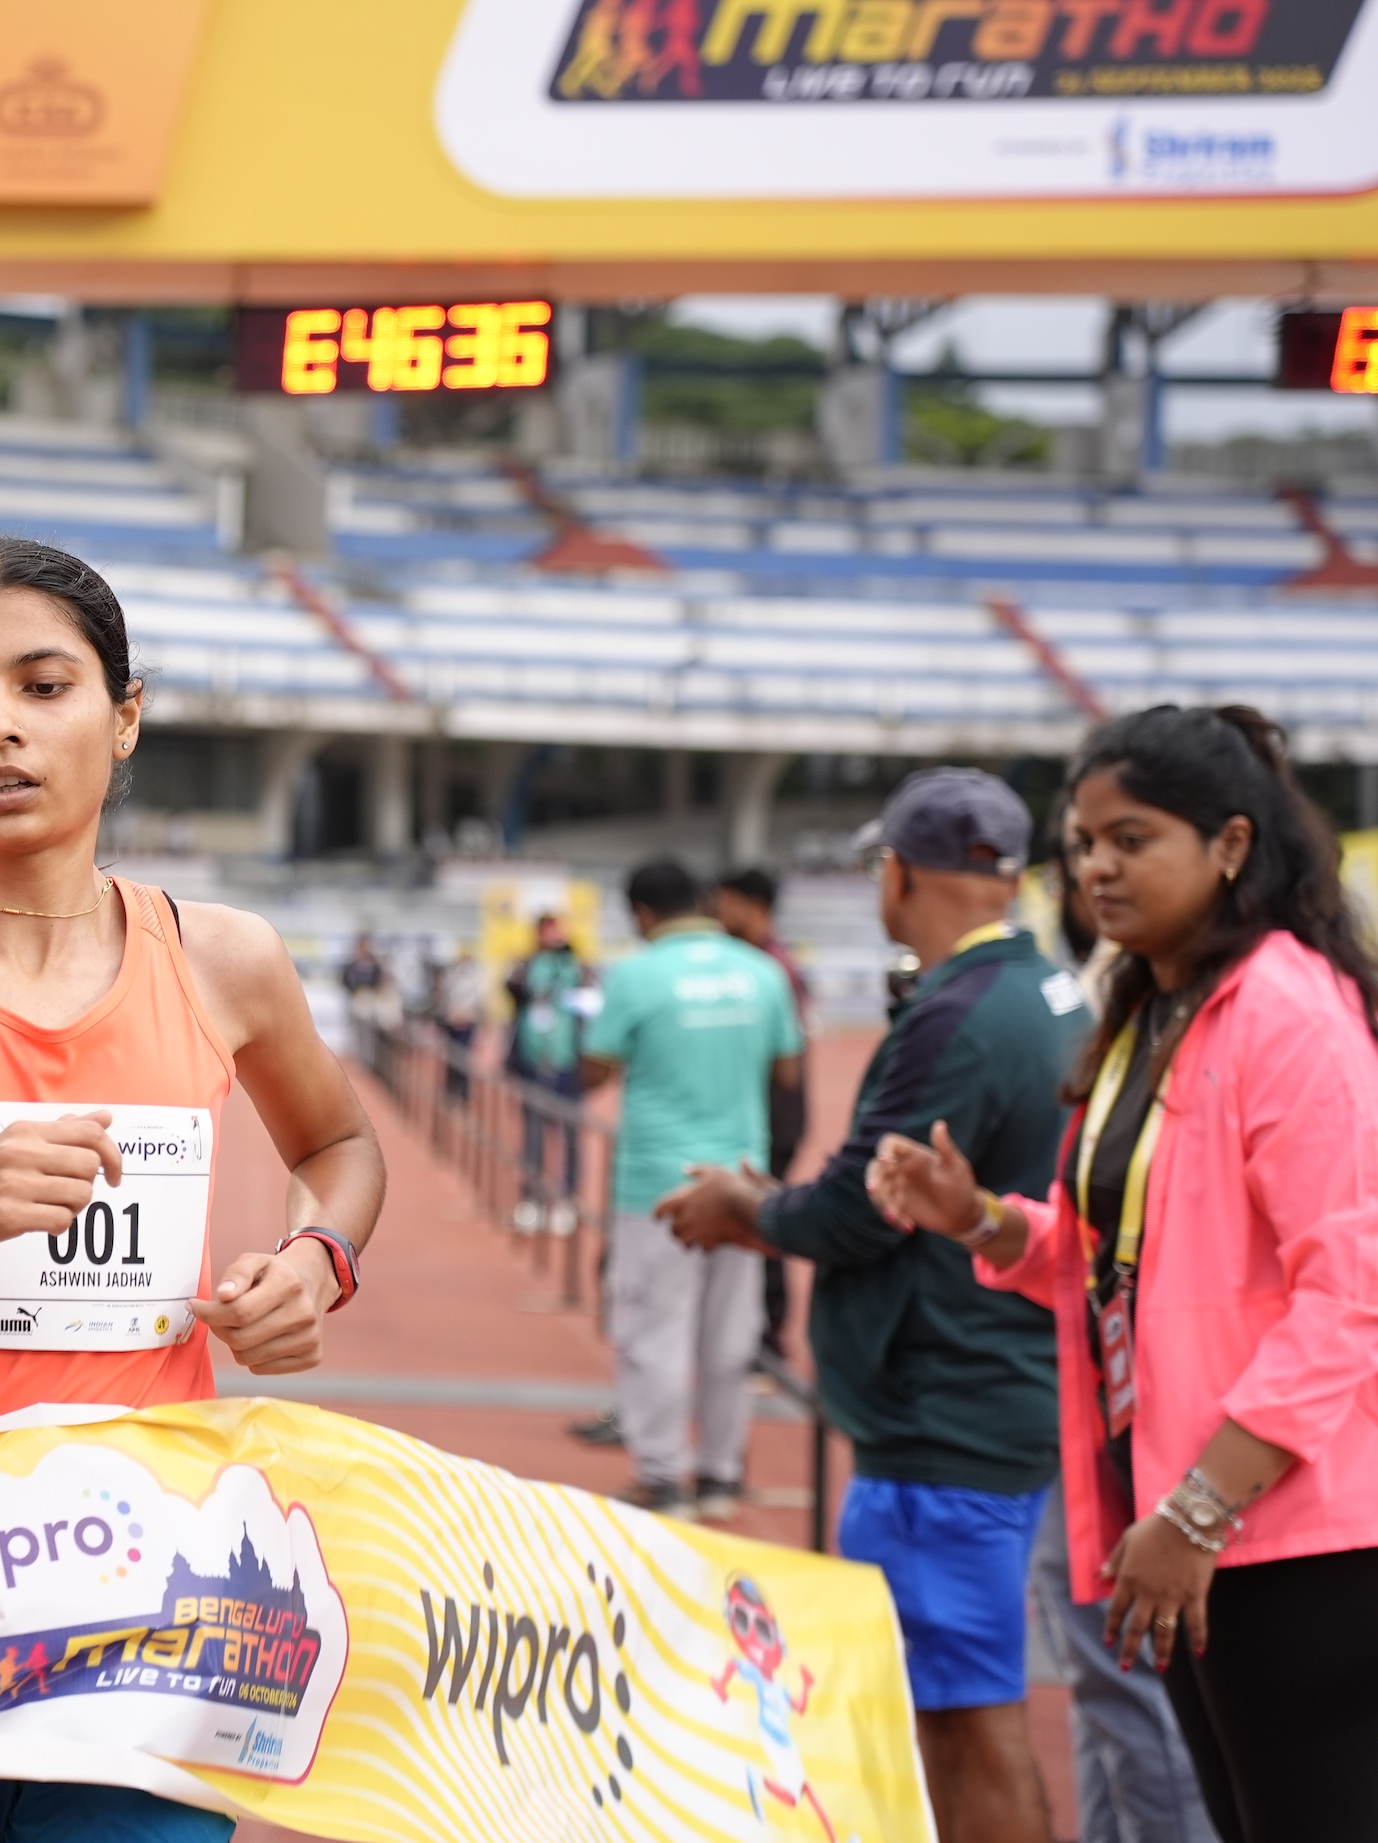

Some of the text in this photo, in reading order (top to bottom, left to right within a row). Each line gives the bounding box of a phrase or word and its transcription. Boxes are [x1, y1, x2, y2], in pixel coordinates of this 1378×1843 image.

[118, 1137, 178, 1161] wipro
[40, 1271, 152, 1288] ASHWINI JADHAV
[420, 1561, 601, 1767] wipro
